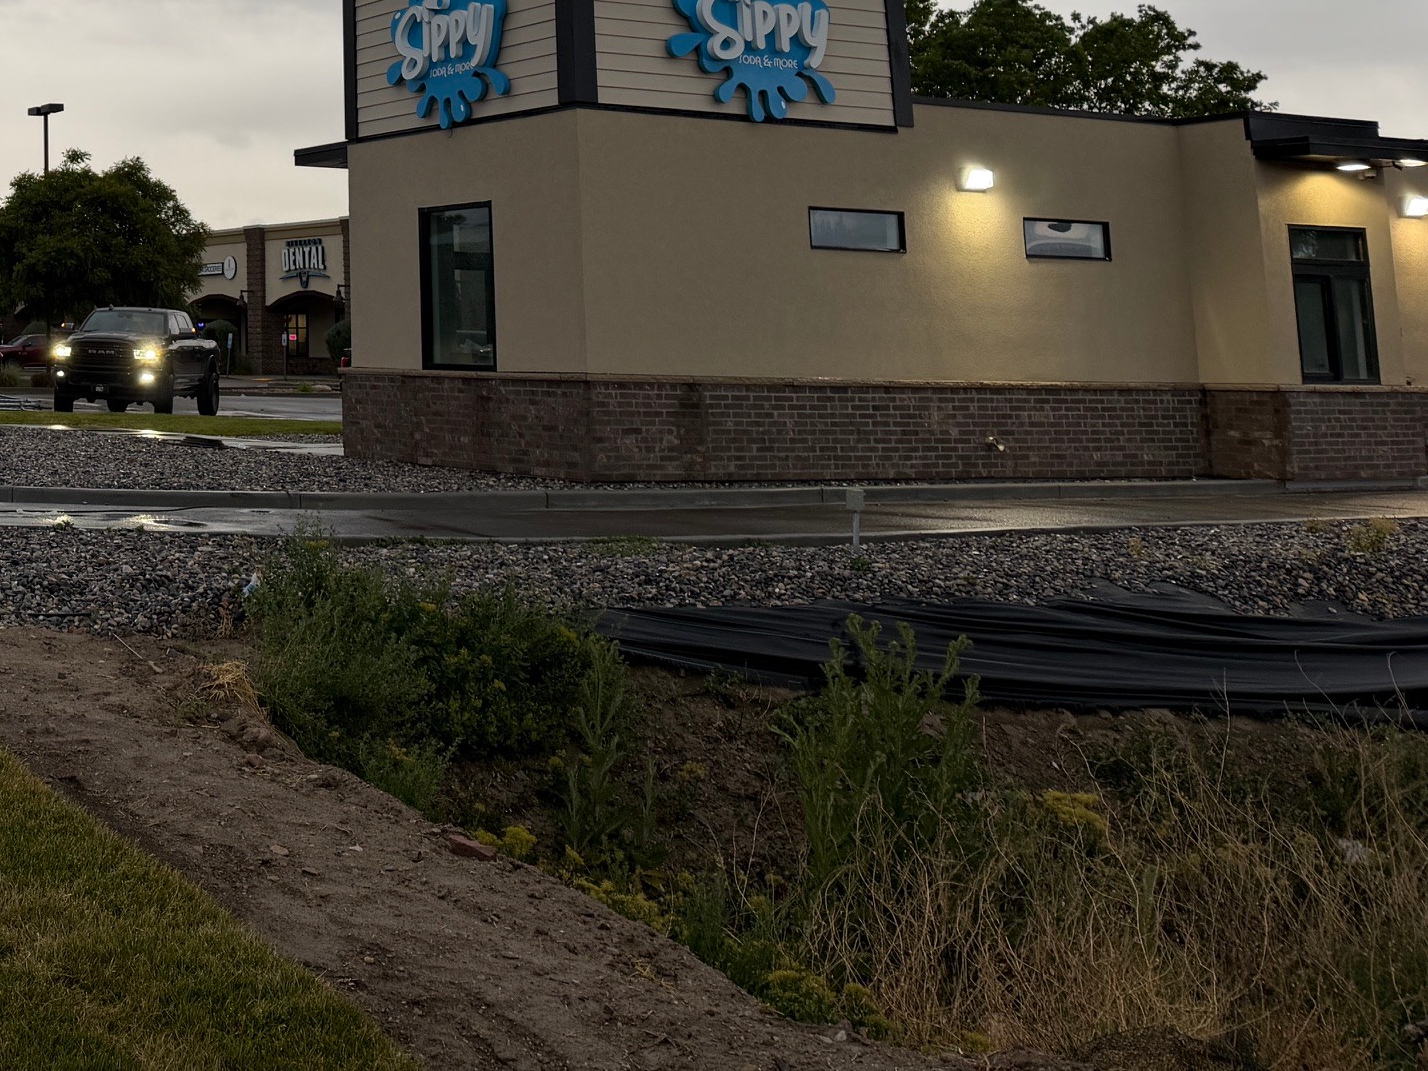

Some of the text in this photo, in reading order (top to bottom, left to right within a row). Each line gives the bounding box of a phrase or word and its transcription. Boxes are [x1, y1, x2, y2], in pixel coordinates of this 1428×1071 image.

[447, 63, 455, 75] &
[739, 55, 798, 70] SODA & MORE
[281, 245, 325, 271] DENTAL
